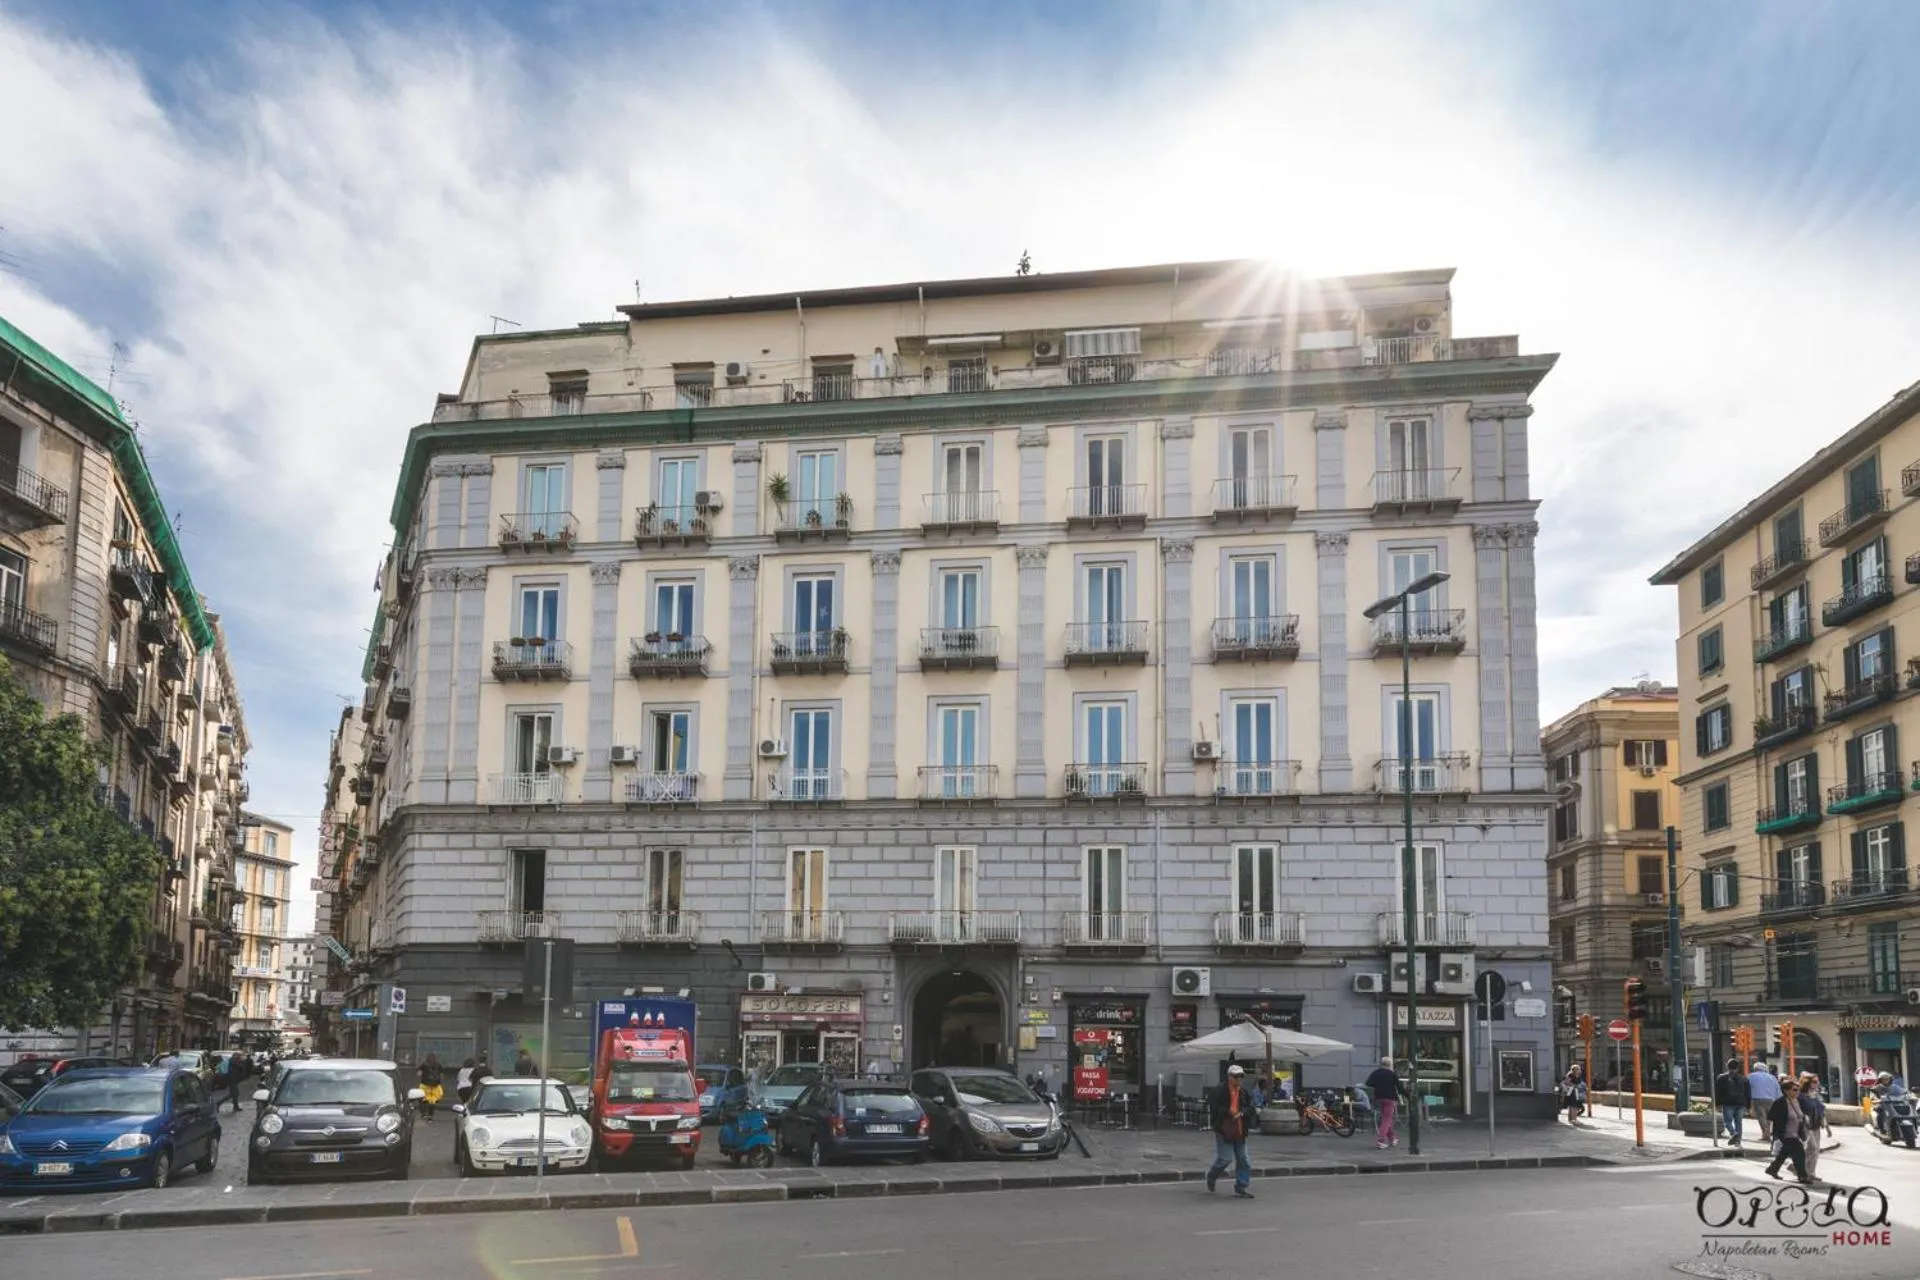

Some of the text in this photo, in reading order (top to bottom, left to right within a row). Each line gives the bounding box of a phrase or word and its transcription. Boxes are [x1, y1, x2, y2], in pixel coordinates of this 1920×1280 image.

[1097, 1009, 1120, 1019] drink
[1082, 1071, 1101, 1080] PASSA
[1077, 1087, 1106, 1095] VODAFONE
